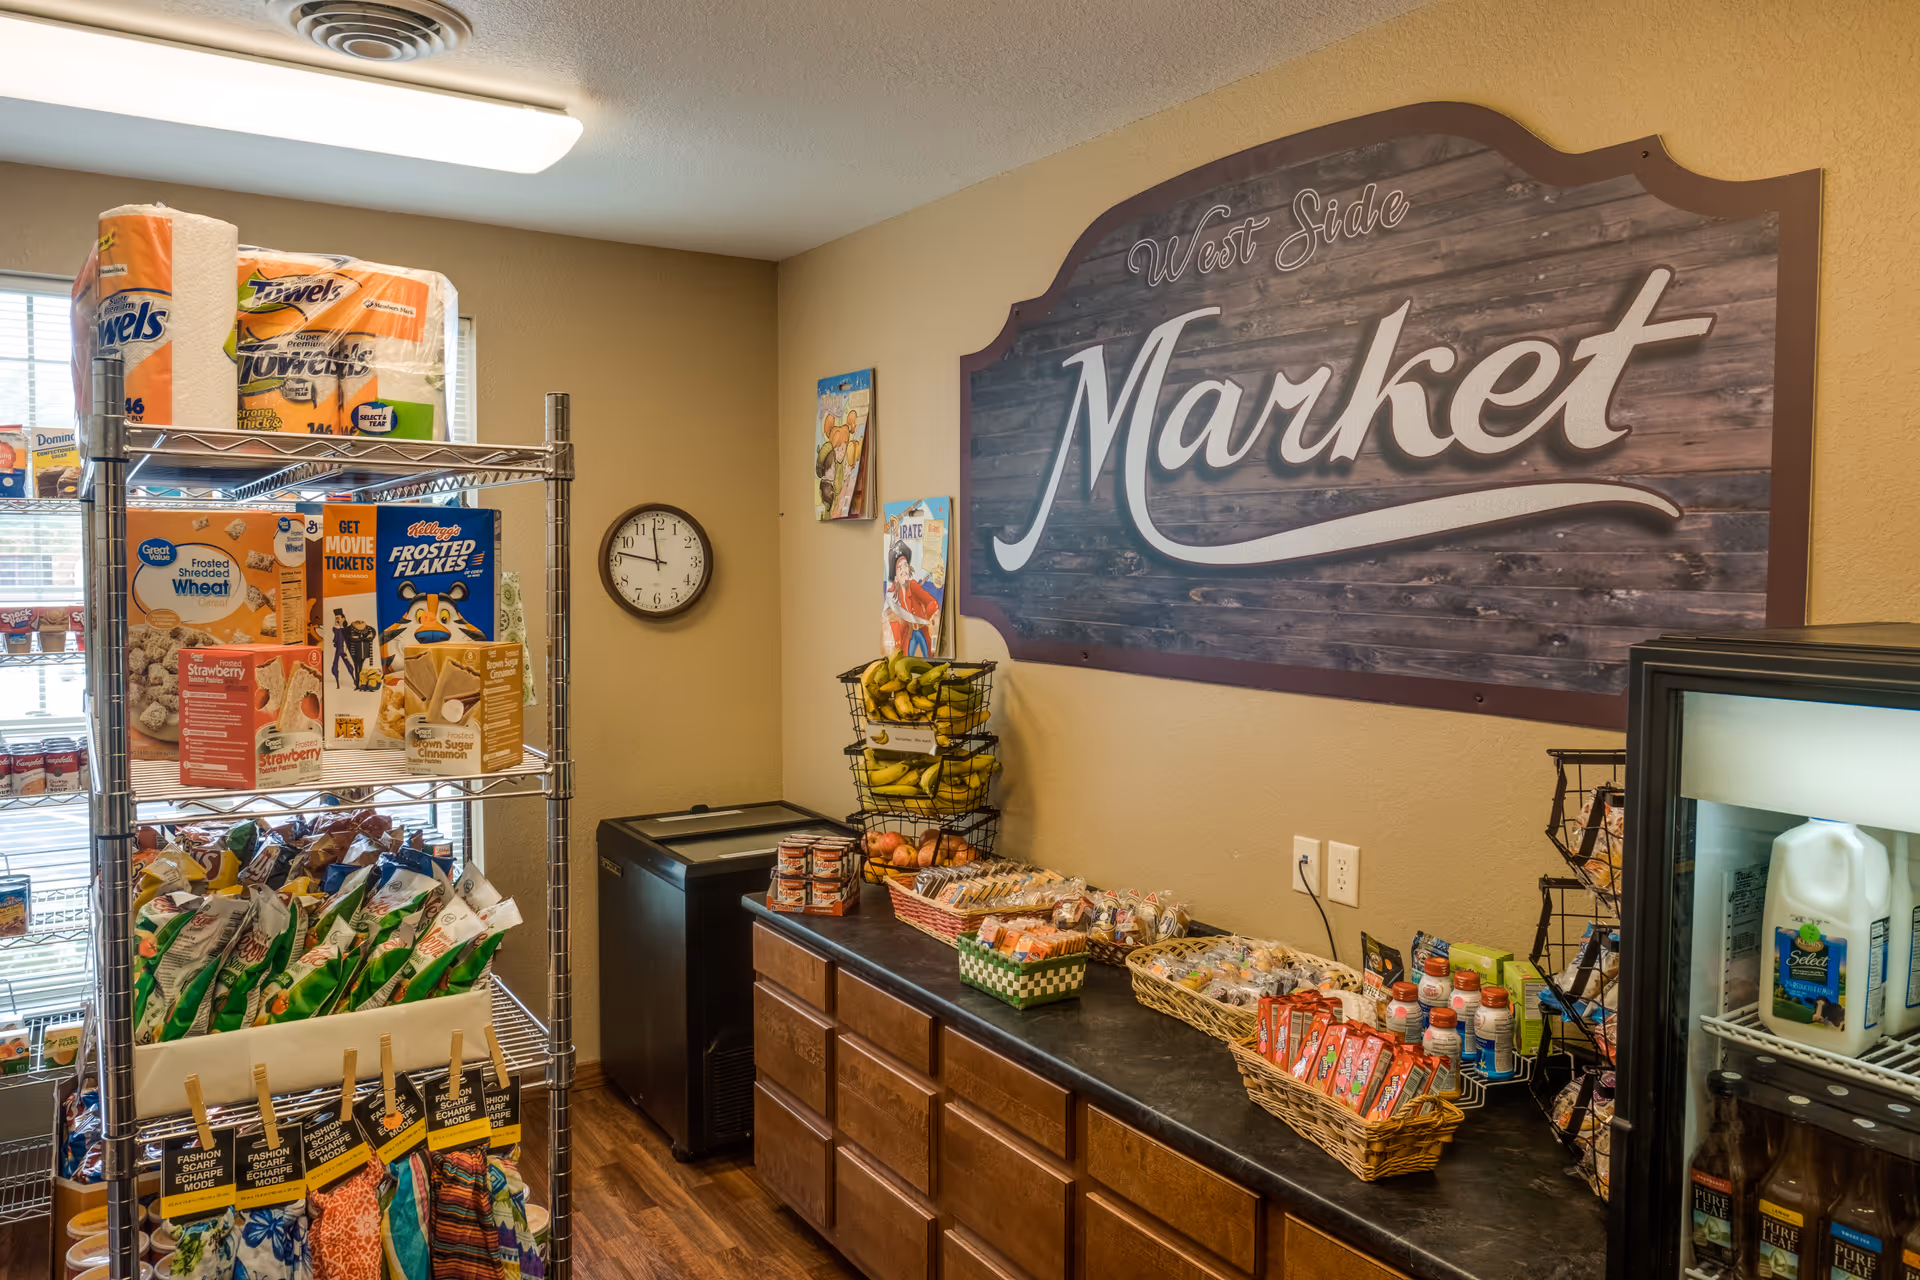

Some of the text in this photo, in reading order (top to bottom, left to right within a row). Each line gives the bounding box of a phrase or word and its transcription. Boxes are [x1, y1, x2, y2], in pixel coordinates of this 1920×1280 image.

[1127, 183, 1410, 287] West Side
[247, 278, 344, 309] Towels
[295, 333, 321, 341] Super
[124, 398, 145, 416] 46
[238, 418, 268, 428] Thick
[993, 264, 1717, 572] Market
[339, 520, 360, 534] GET
[407, 520, 462, 541] Kellogg's
[634, 523, 646, 536] 11
[652, 517, 665, 531] 12
[671, 523, 678, 536] 1
[900, 523, 923, 540] IRATE
[325, 535, 374, 555] MOVIE
[621, 535, 635, 549] 10
[683, 535, 692, 549] 2
[142, 545, 170, 555] Great
[149, 552, 170, 561] Value
[388, 539, 477, 563] FROSTED
[191, 558, 230, 569] Frosted
[324, 555, 374, 571] TICKETS
[393, 555, 469, 578] FLAKES
[614, 553, 622, 568] 9
[690, 555, 698, 569] 3
[178, 567, 230, 578] Shredded
[682, 573, 691, 586] 4
[171, 578, 230, 597] Wheat
[620, 574, 629, 587] 8
[634, 587, 643, 601] 7
[653, 592, 661, 605] 6
[670, 587, 679, 600] 5
[1, 608, 33, 624] Snack
[9, 615, 30, 628] Pack
[311, 652, 317, 660] 8
[188, 663, 246, 681] Strawberry
[447, 731, 475, 740] Frosted
[295, 740, 318, 749] Frosted
[411, 738, 474, 752] Brown Sugar
[258, 747, 322, 768] Strawberry
[417, 747, 468, 759] Cinnamon
[1785, 949, 1830, 966] Select
[58, 1035, 78, 1043] DICED
[58, 1040, 79, 1048] PEARS
[435, 1087, 472, 1103] FASON
[486, 1094, 510, 1105] SHION
[370, 1094, 407, 1121] FASON
[440, 1096, 469, 1110] SCARF
[444, 1114, 471, 1127] MODE
[489, 1110, 512, 1120] ARPE
[303, 1119, 343, 1144] FASHION
[389, 1117, 415, 1138] MODE
[311, 1128, 342, 1149] SCARF
[177, 1149, 222, 1165] FASHION
[247, 1147, 290, 1163] FASHION
[320, 1144, 348, 1164] MODE
[182, 1159, 217, 1173] SCARF
[253, 1156, 286, 1170] SCARF
[184, 1178, 215, 1192] MODE
[255, 1174, 285, 1188] MODE
[1695, 1188, 1729, 1209] PURE
[1695, 1199, 1728, 1220] LEAF
[1762, 1219, 1799, 1243] PURE
[1841, 1229, 1870, 1245] SWEET TEA
[1762, 1229, 1795, 1252] LEAF
[1835, 1244, 1876, 1270] PURE
[1834, 1254, 1872, 1280] LEAF
